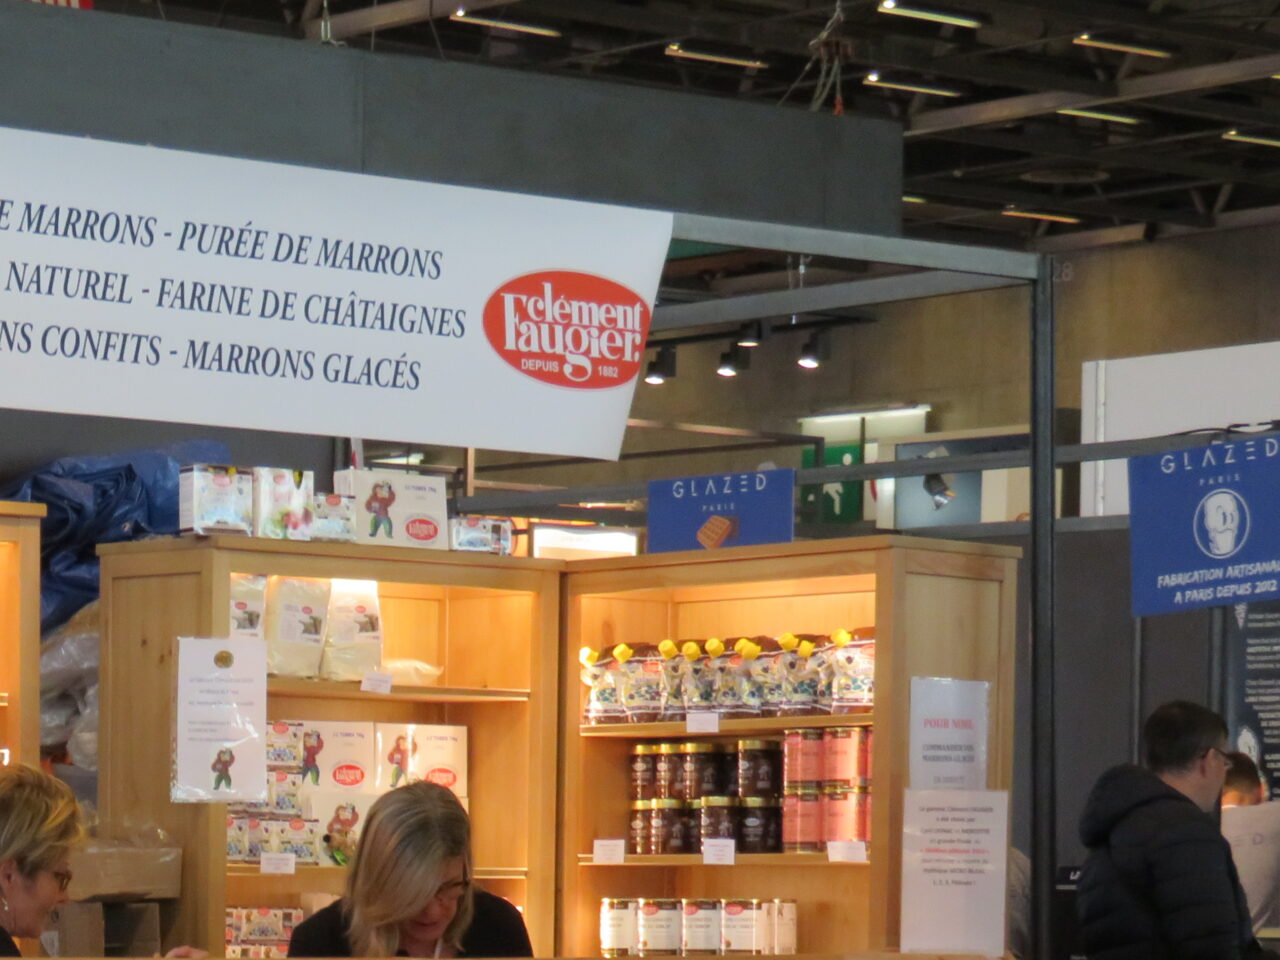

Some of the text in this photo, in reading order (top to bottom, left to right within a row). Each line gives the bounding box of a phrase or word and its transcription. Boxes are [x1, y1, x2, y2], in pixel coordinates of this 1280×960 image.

[17, 202, 158, 247] MARRONS
[177, 220, 269, 262] PURÉE
[273, 231, 313, 265] DE
[313, 237, 444, 280] MARRONS
[3, 260, 135, 304] NATUREL
[155, 277, 253, 318] FARINE
[258, 290, 298, 322] DE
[303, 290, 468, 339] CHÂTAIGNES
[526, 282, 643, 332] clément
[40, 324, 163, 367] CONFITS
[182, 338, 316, 381] MARRONS
[322, 352, 421, 391] GLACÉS
[521, 358, 619, 379] DEPUIS 1882
[1160, 438, 1279, 474] GLAZED
[672, 473, 767, 498] GLAZED
[1199, 473, 1241, 487] PARIS
[1157, 567, 1224, 589] FABRICATION
[1174, 579, 1278, 604] A PARIS DEPUIS 2012
